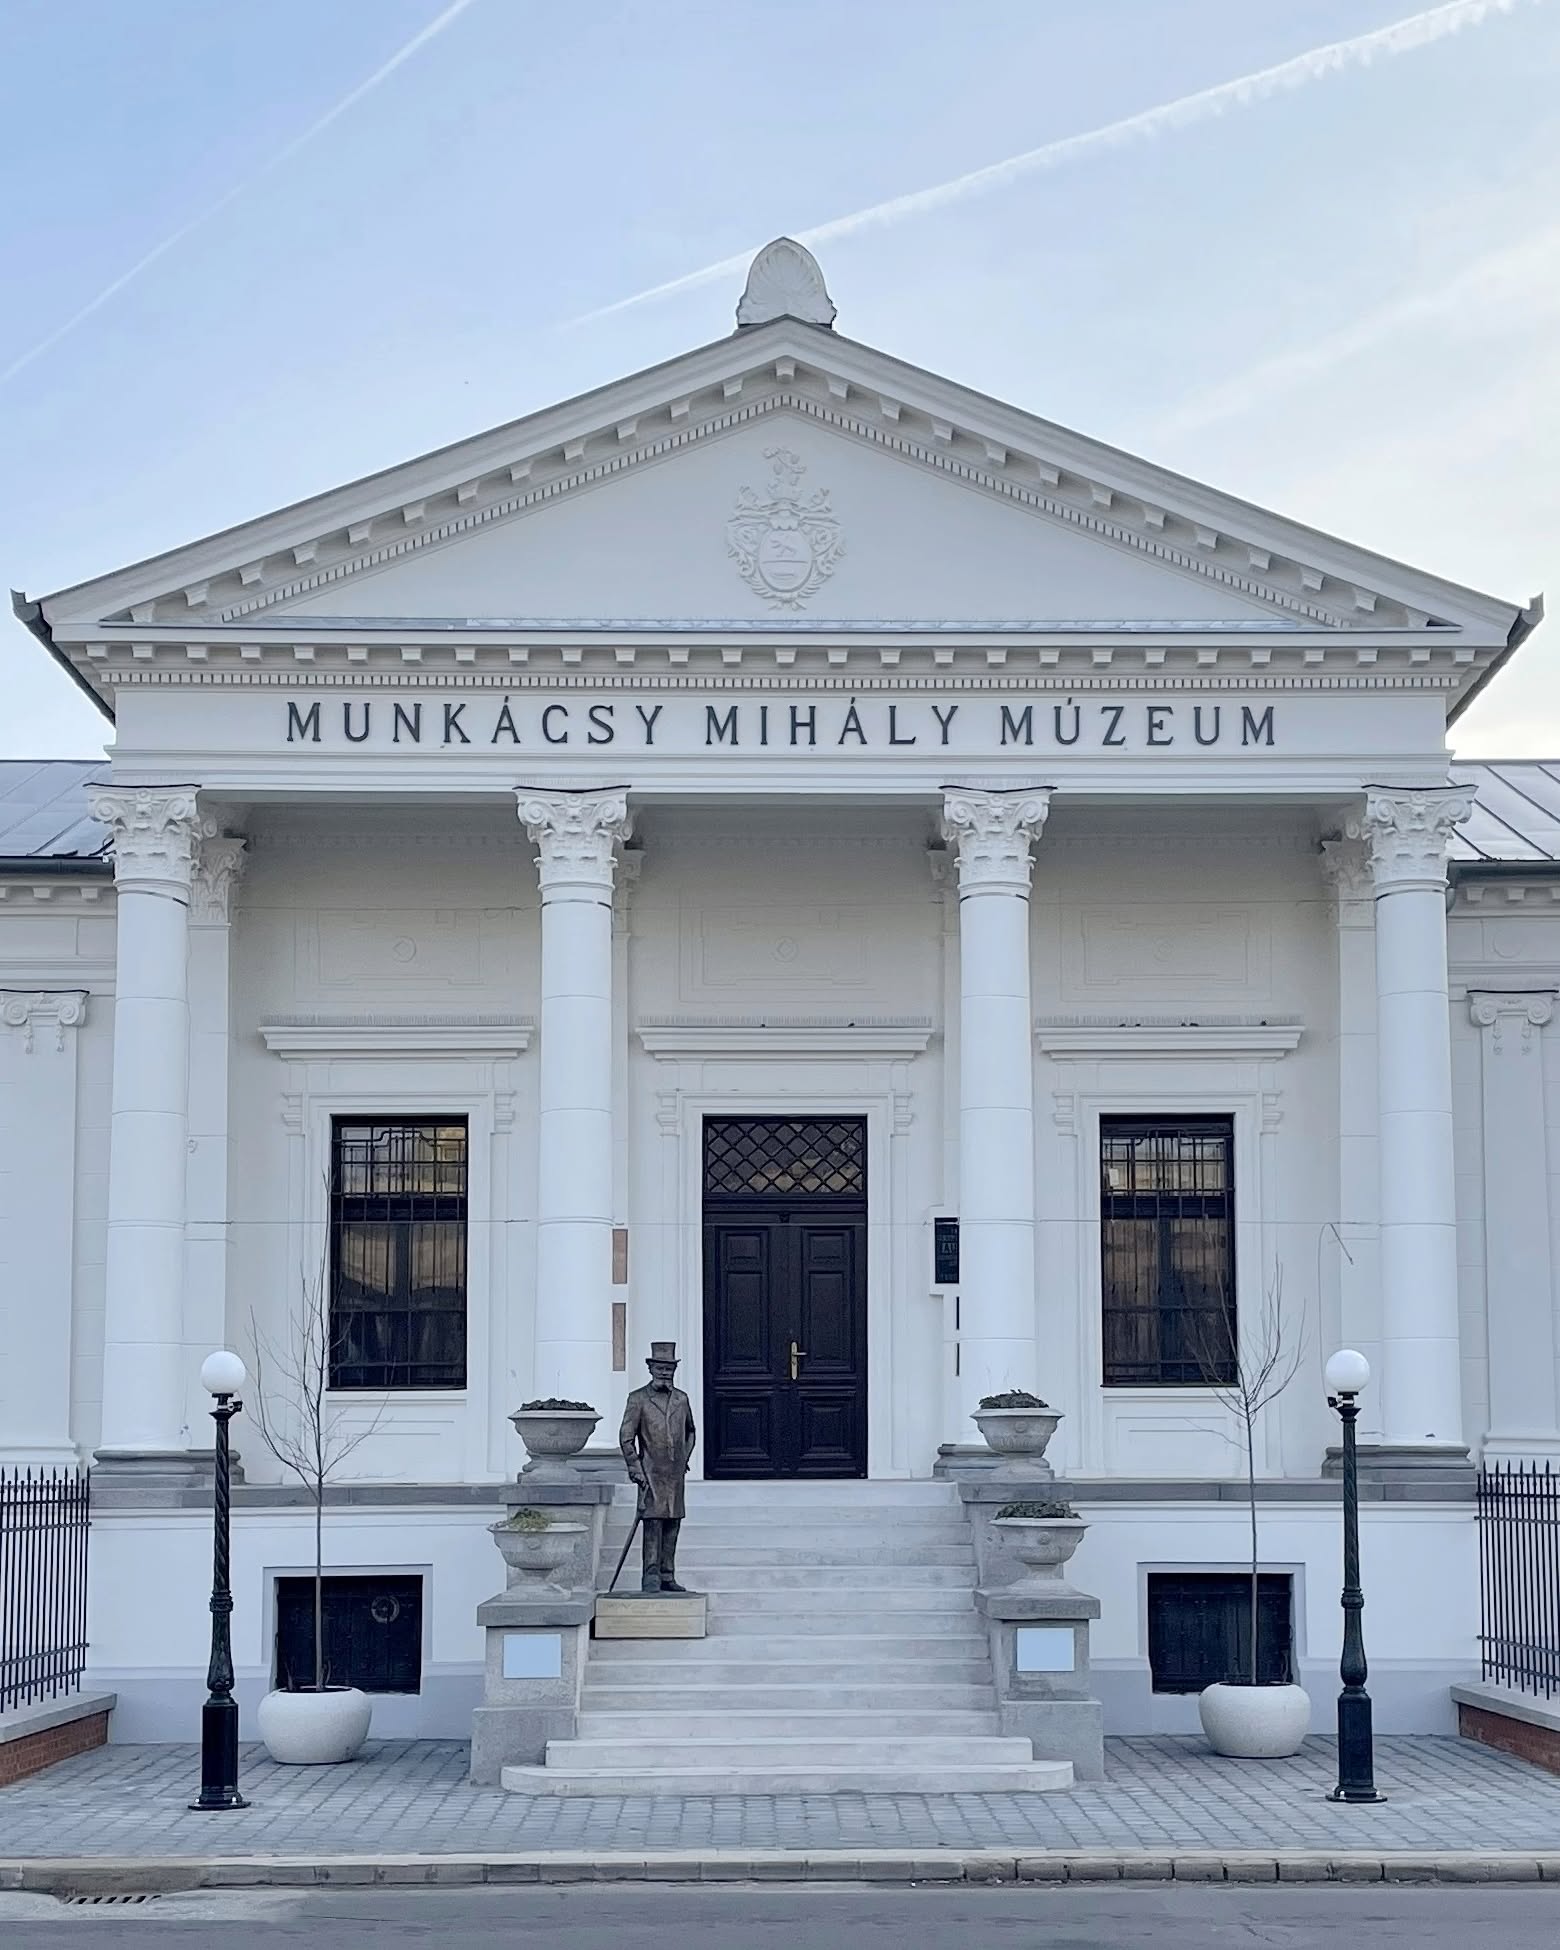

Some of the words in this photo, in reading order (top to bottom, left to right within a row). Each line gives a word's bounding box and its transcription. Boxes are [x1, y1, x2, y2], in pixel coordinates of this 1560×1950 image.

[286, 696, 664, 745] MUNKÁCSY
[705, 697, 959, 746] MIHÁLY
[1000, 697, 1275, 746] MÚZEUM
